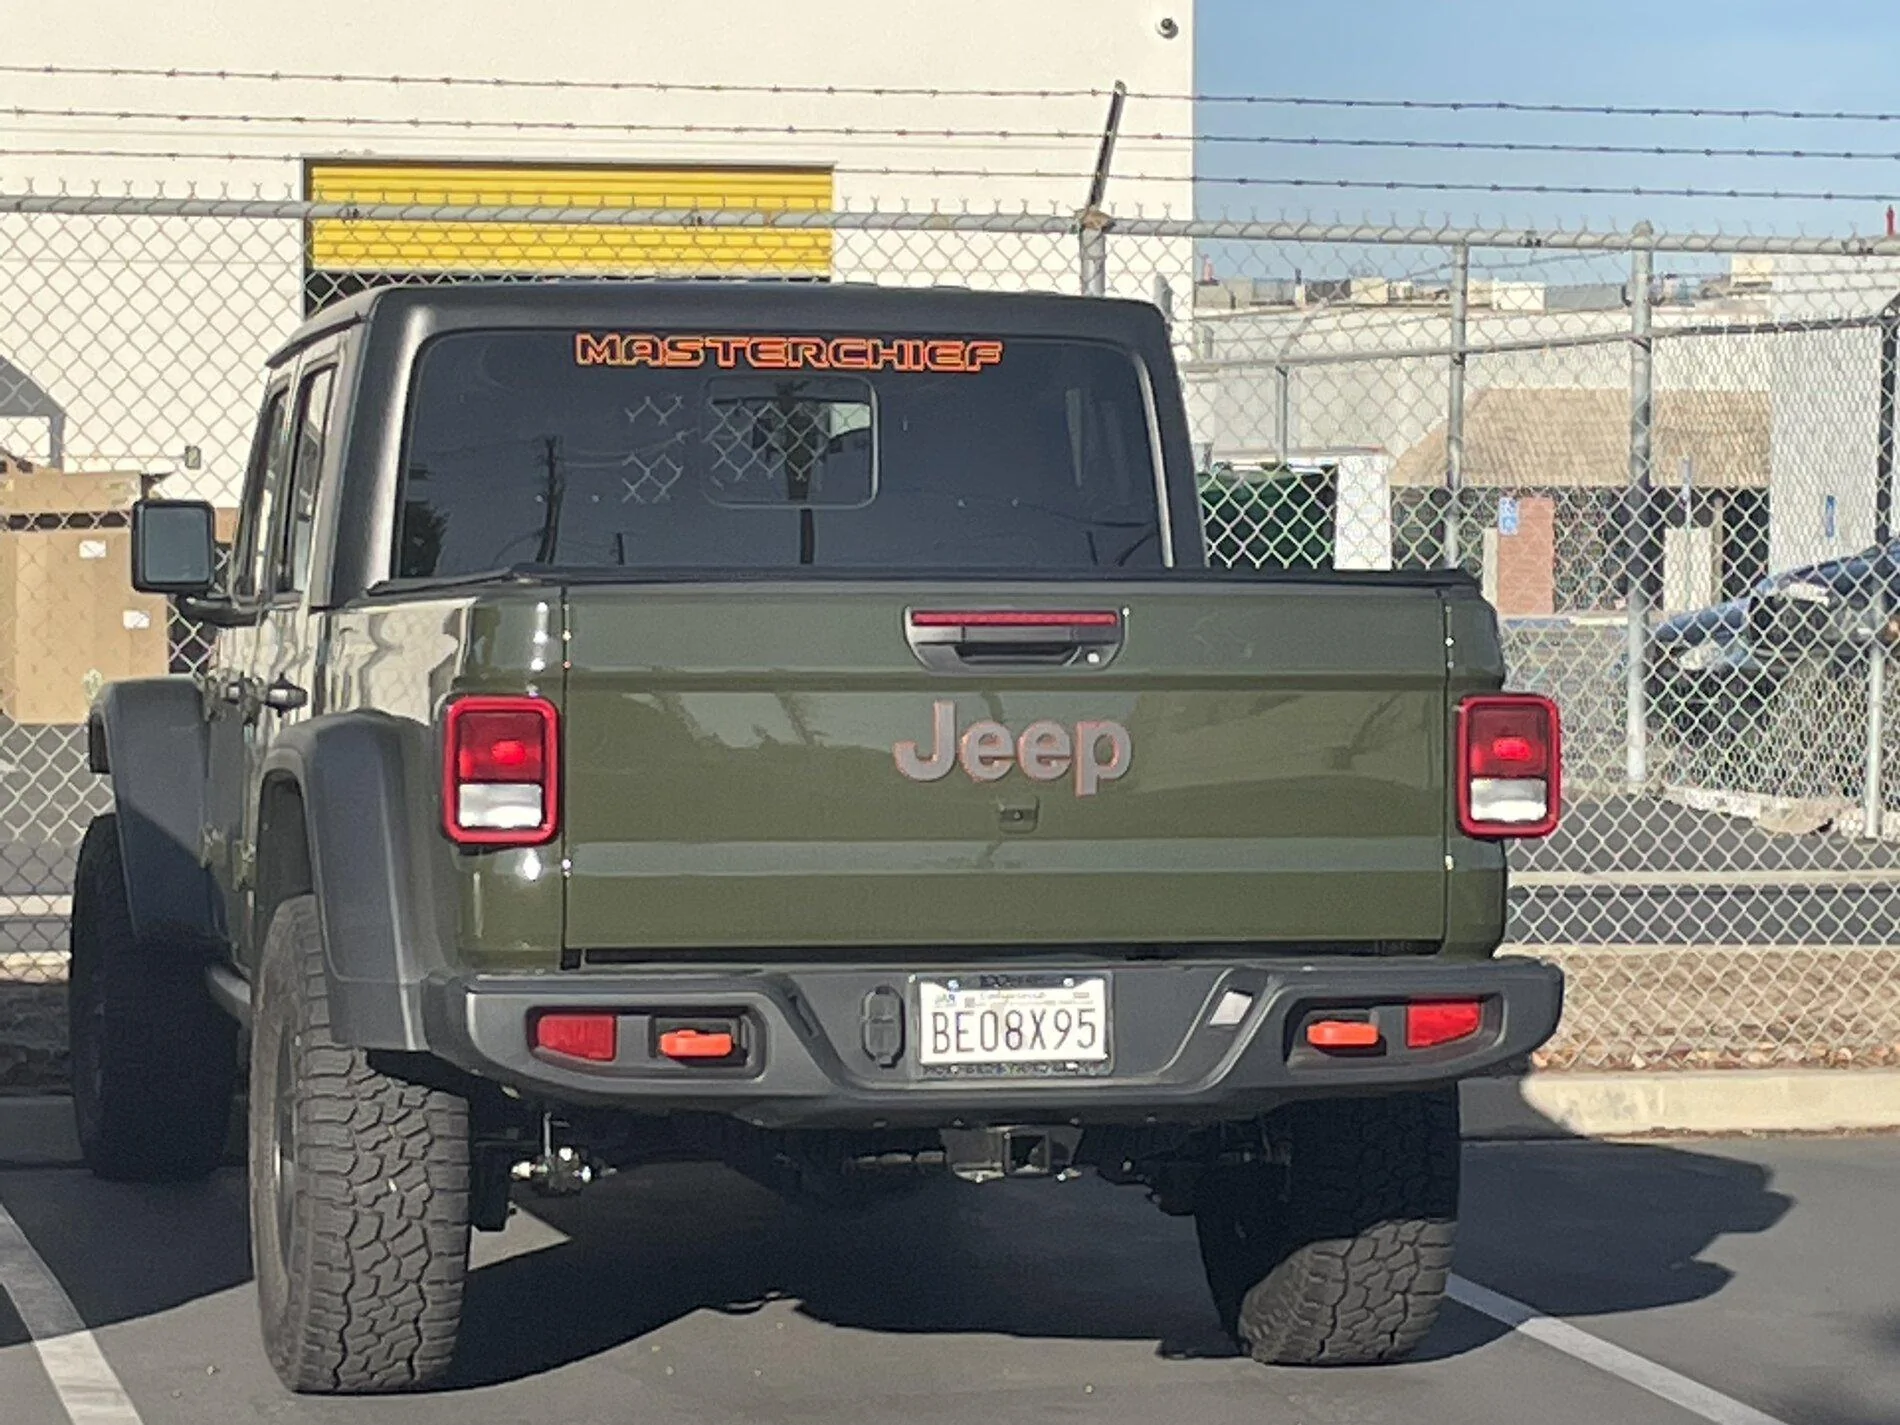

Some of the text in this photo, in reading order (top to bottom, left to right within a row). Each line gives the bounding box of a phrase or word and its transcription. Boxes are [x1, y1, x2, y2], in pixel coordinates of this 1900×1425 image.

[575, 332, 1003, 372] MASTERCHIEF
[893, 700, 1132, 797] Jeep
[932, 1008, 1096, 1054] BE08X95
